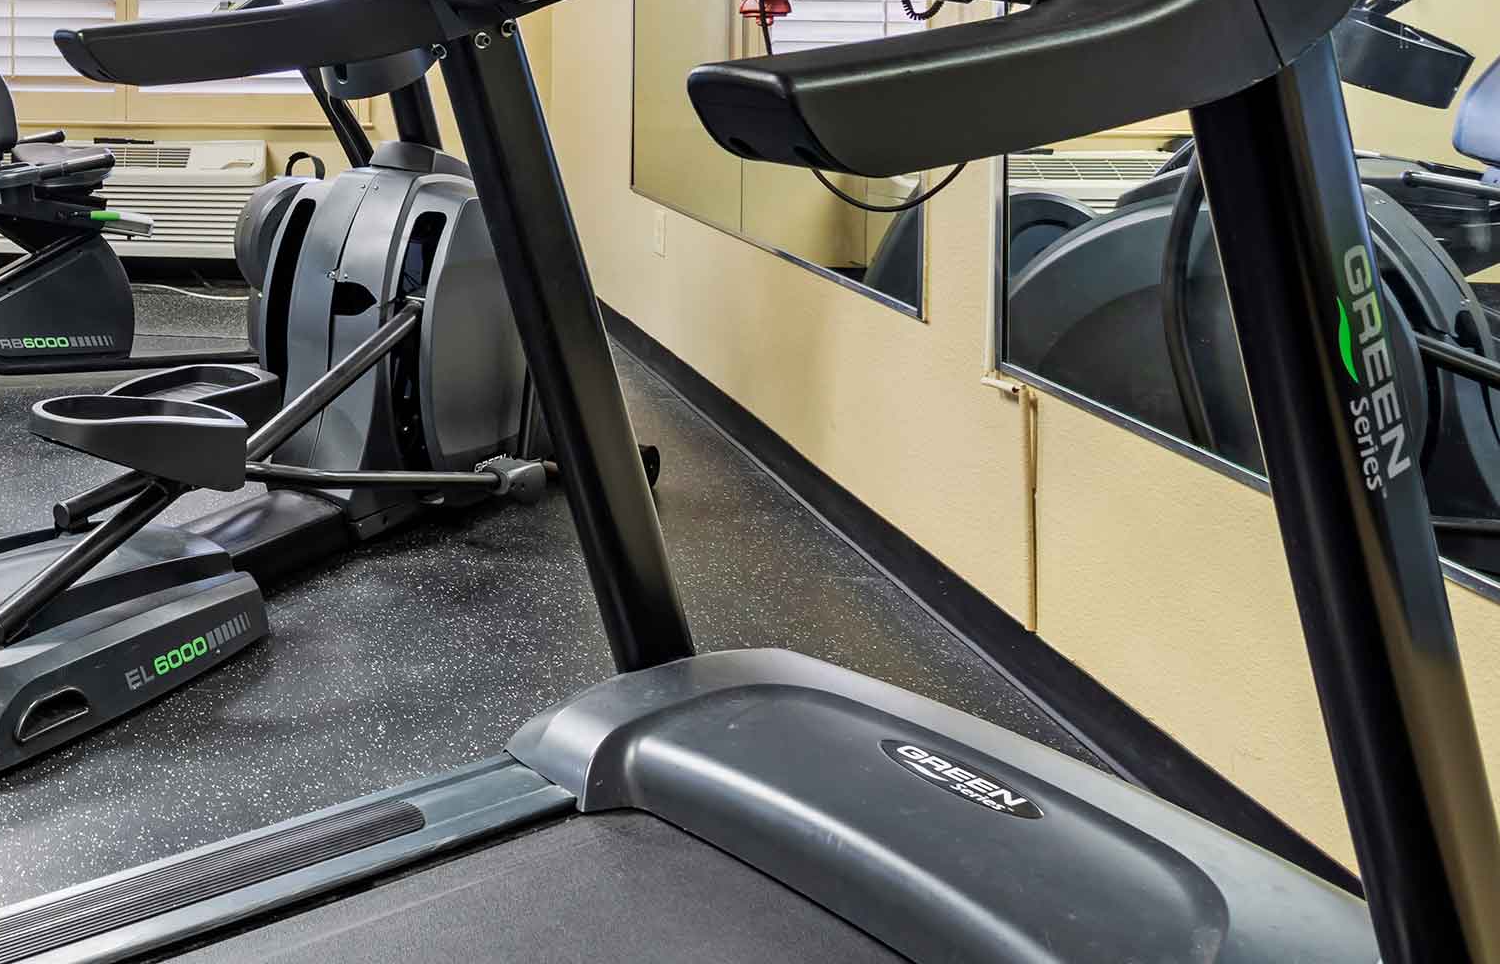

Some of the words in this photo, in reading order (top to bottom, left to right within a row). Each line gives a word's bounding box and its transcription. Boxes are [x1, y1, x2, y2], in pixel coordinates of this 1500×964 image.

[0, 336, 70, 350] RB6000
[1344, 244, 1412, 480] GREEN
[1350, 396, 1384, 492] Series
[896, 744, 1028, 807] GREEN
[950, 782, 1006, 812] Series
